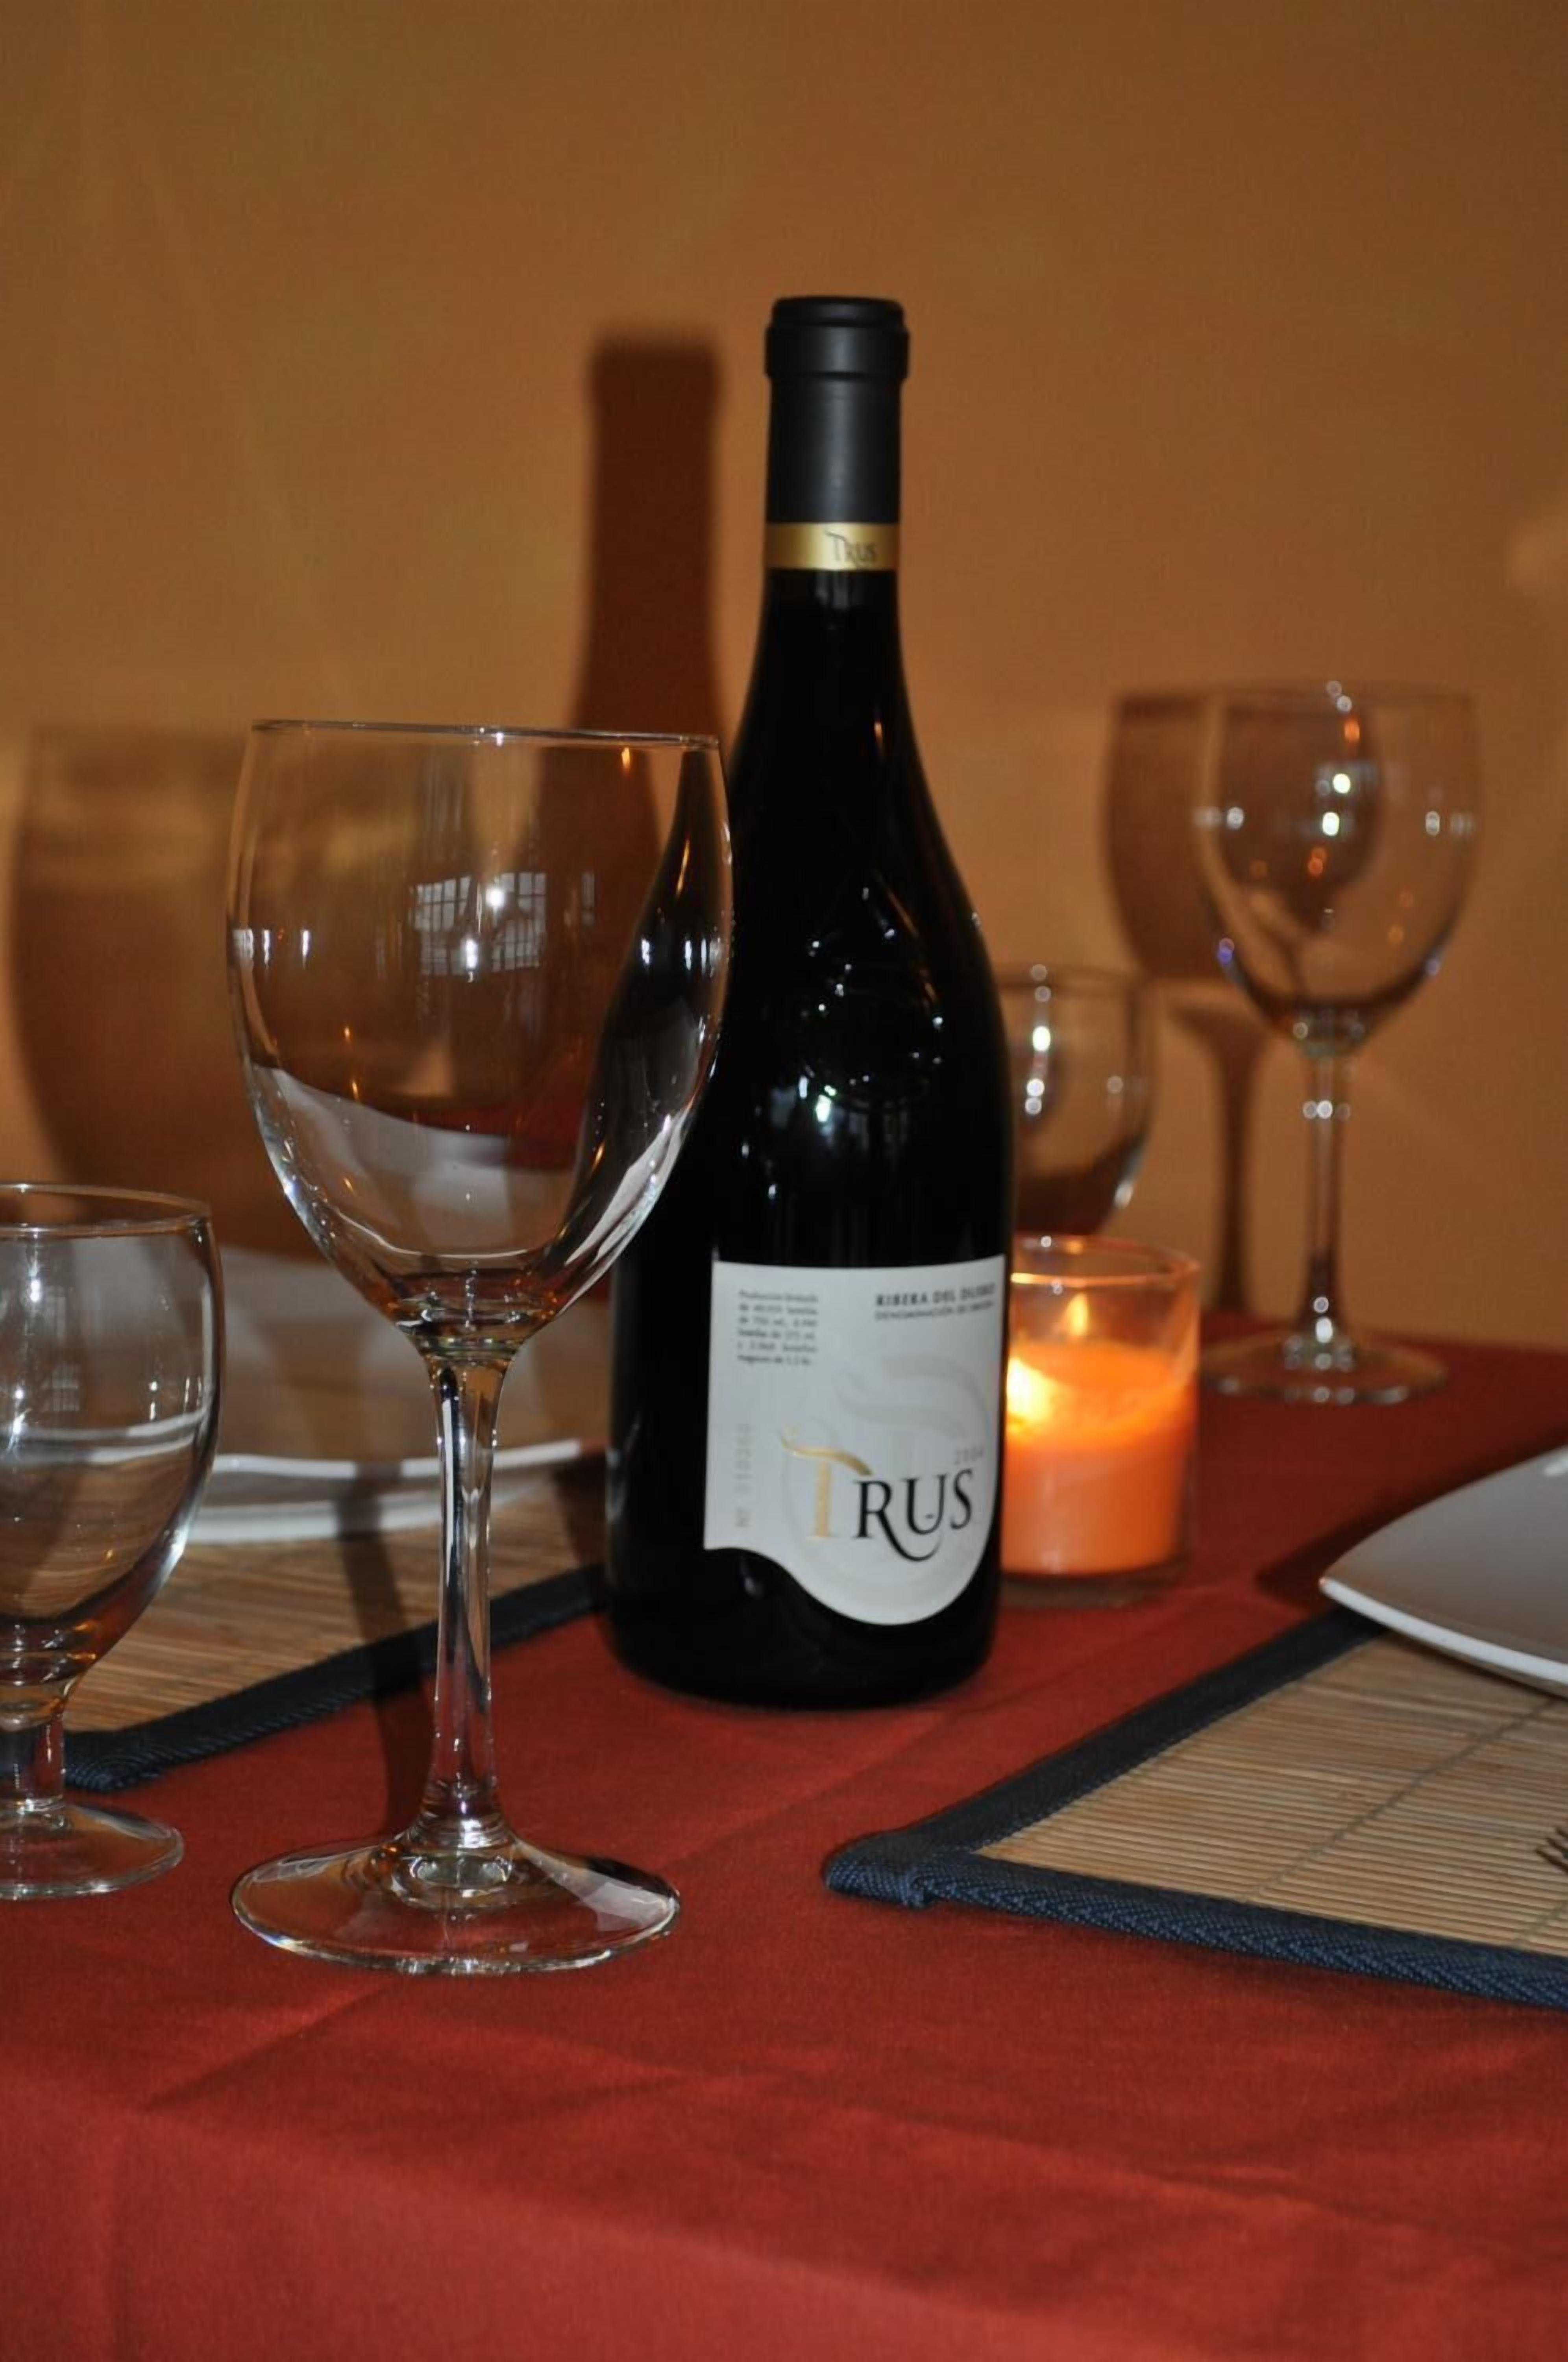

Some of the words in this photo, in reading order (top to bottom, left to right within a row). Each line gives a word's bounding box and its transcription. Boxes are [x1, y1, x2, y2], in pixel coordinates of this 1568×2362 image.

[876, 1291, 928, 1307] RIBERA
[933, 1289, 956, 1305] DEL
[779, 1431, 973, 1562] TRUS
